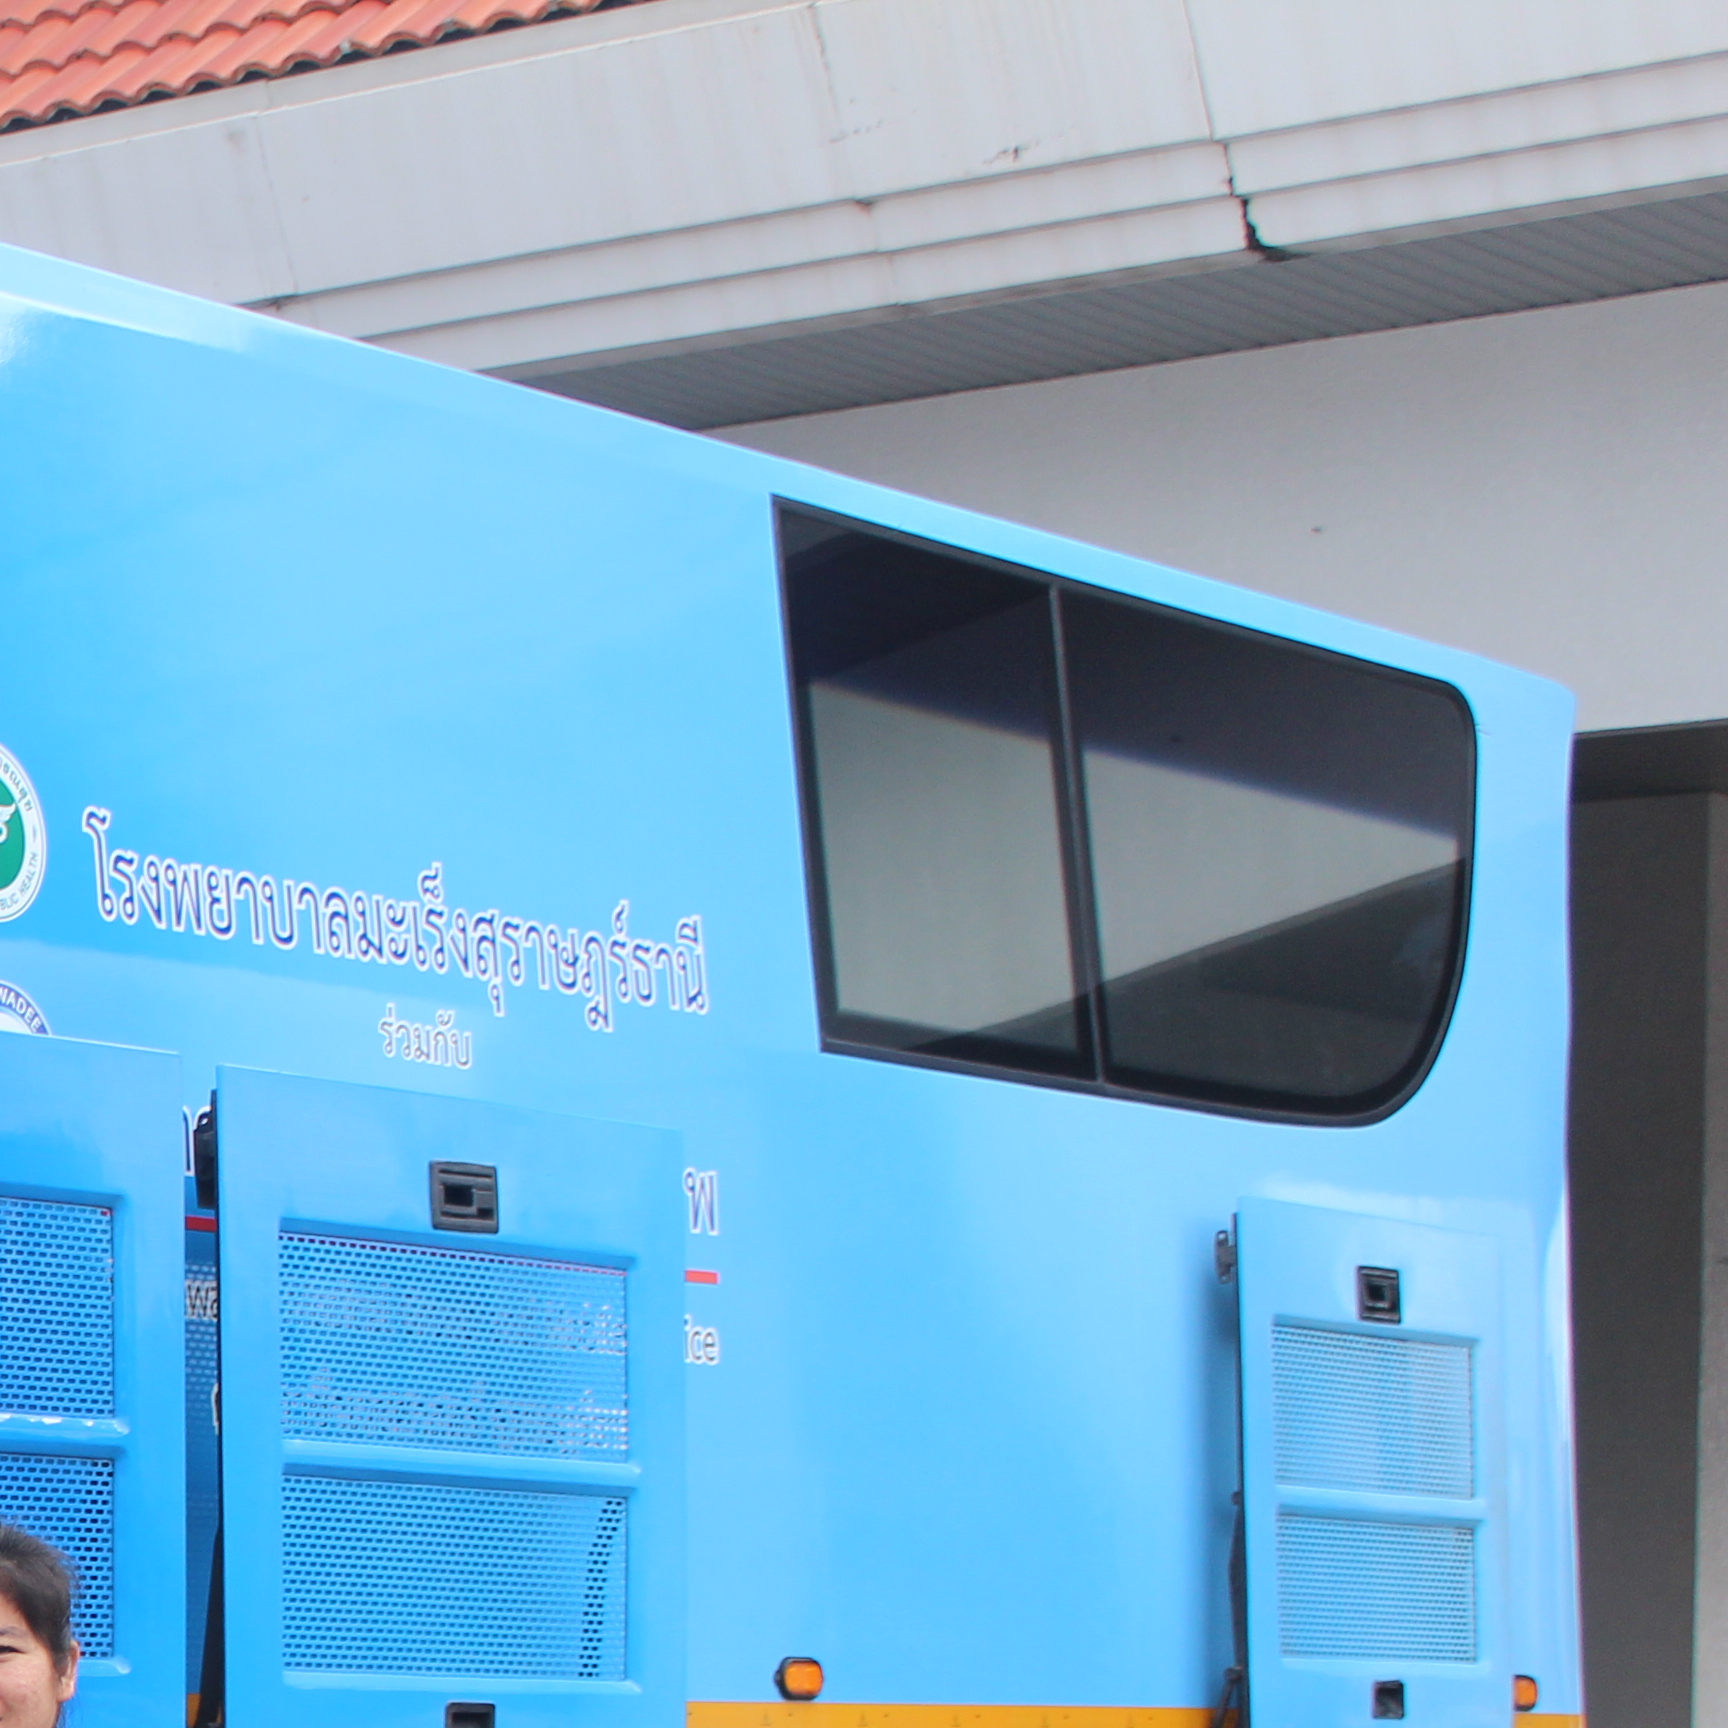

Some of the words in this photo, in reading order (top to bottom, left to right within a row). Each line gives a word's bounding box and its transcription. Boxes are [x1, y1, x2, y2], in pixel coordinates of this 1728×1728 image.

[19, 851, 39, 899] HEALTH
[82, 804, 710, 1032] โรงพยาบาลมะเร็งสุราษฎร์ธานี
[377, 1003, 473, 1069] ร่วมกับ
